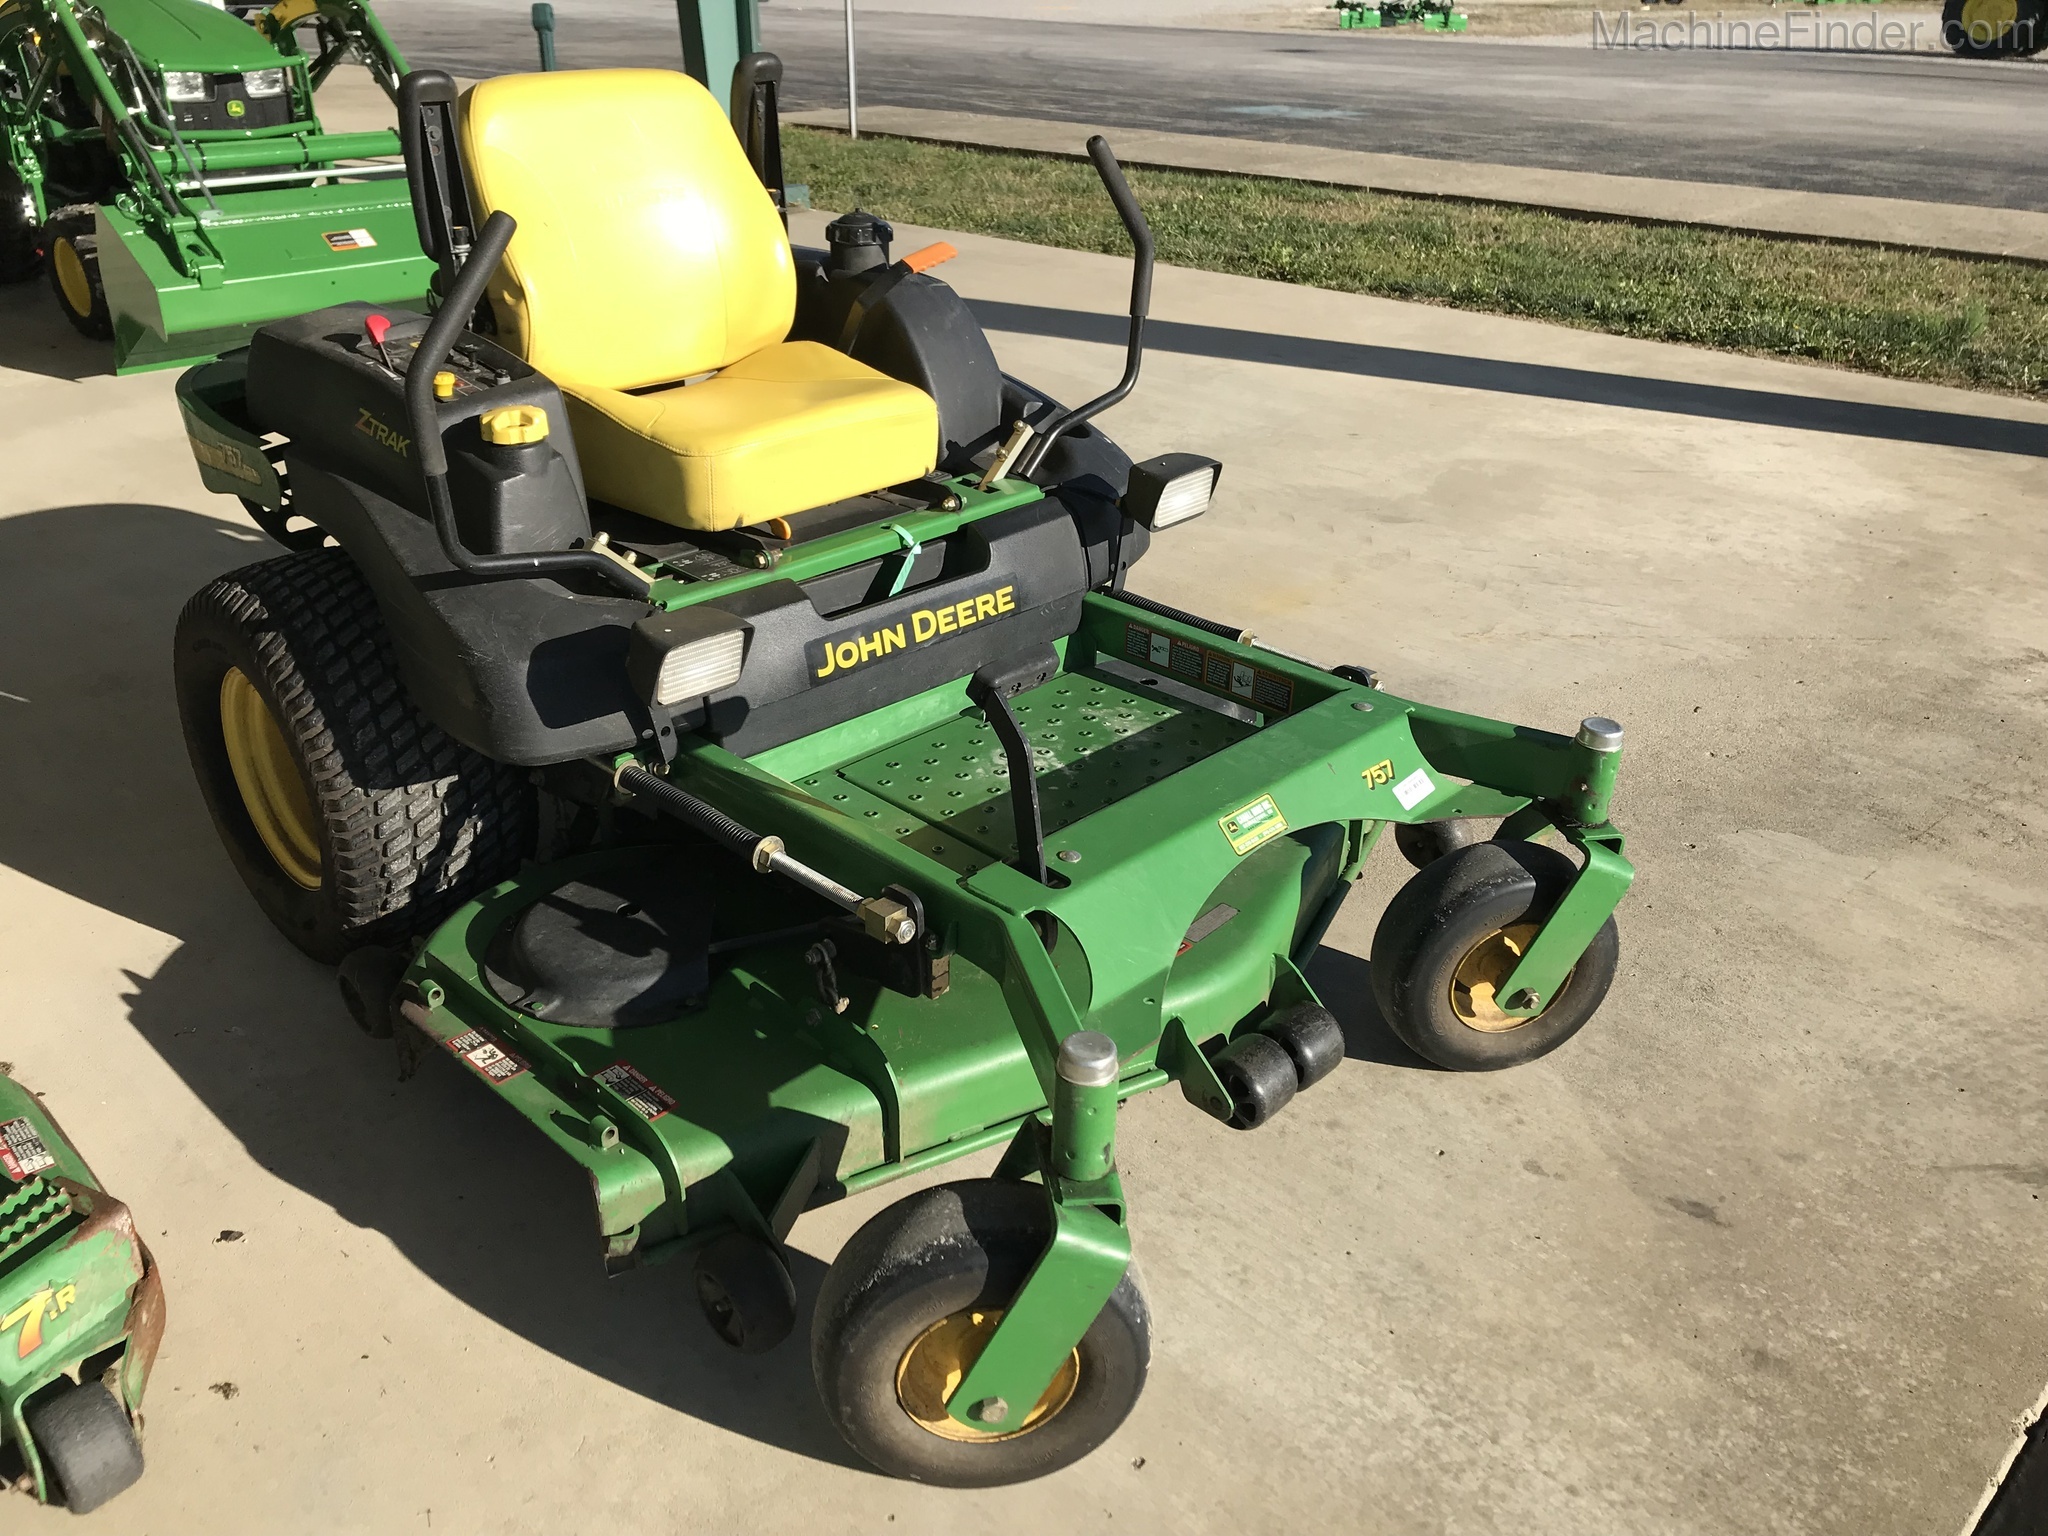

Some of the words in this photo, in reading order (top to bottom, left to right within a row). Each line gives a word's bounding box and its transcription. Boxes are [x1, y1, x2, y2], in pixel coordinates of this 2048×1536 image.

[817, 623, 907, 678] JOHN
[911, 585, 1016, 643] DEERE
[1361, 758, 1395, 790] 757
